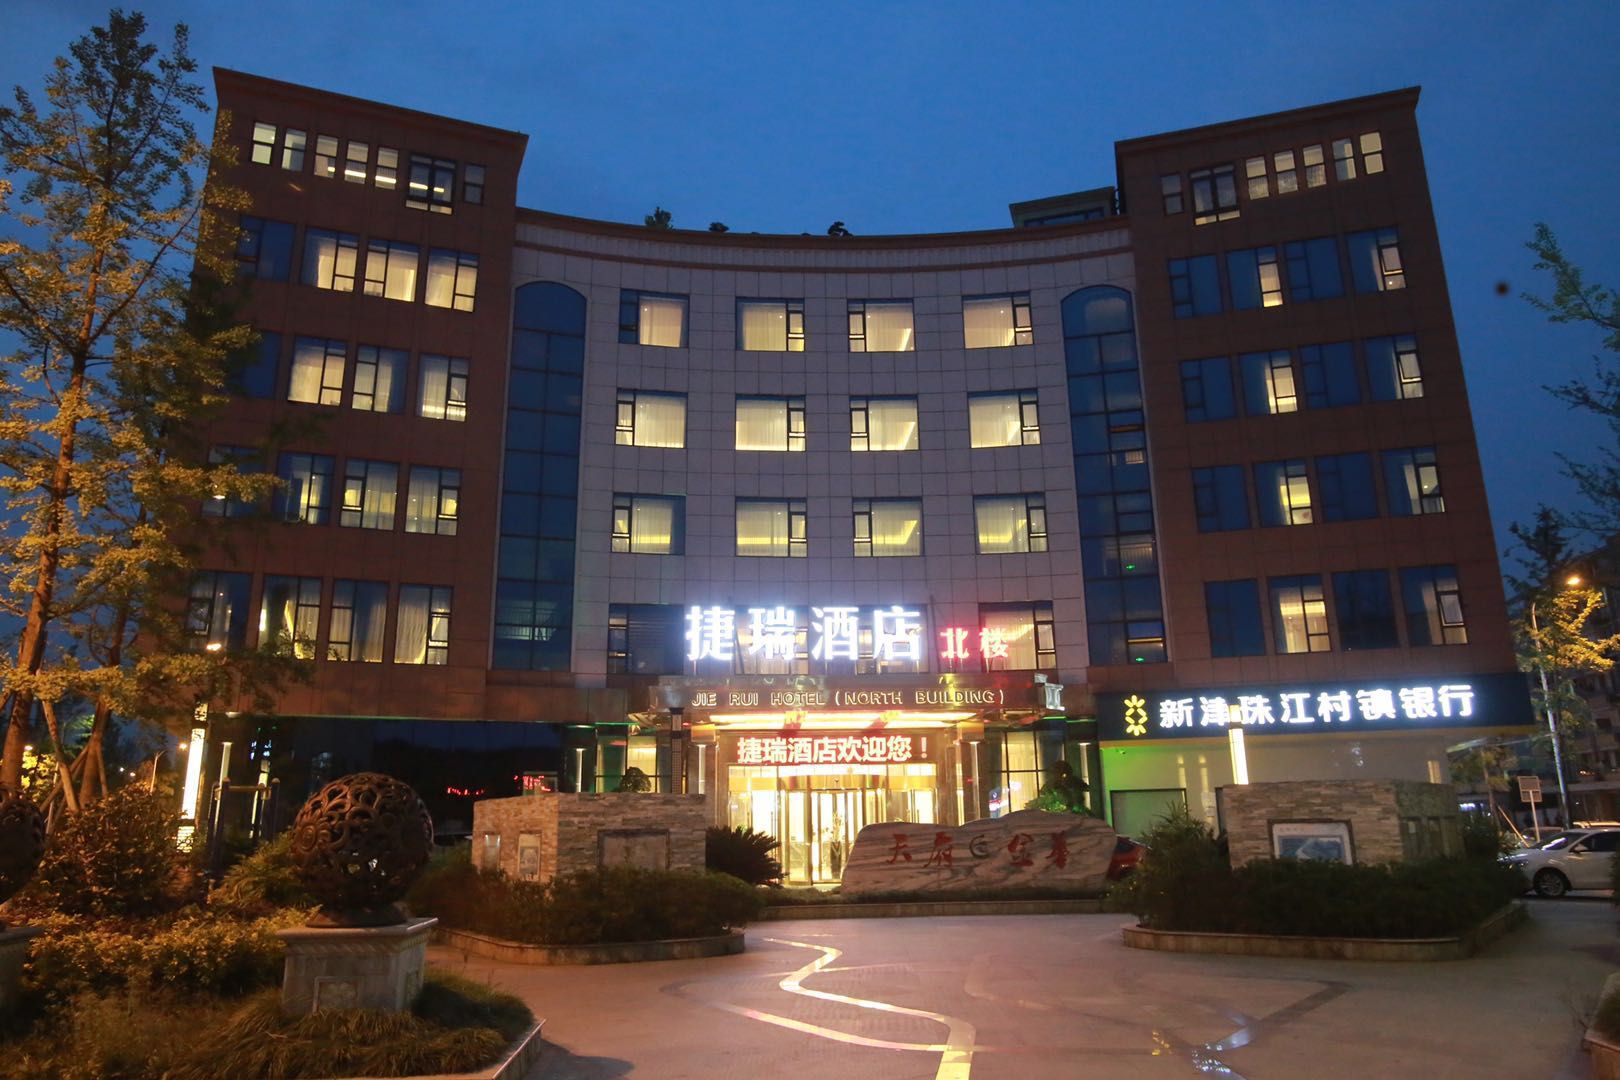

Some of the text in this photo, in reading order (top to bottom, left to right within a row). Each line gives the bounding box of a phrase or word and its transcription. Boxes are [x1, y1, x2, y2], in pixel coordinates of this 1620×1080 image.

[685, 604, 922, 662] 捷瑞酒店
[939, 627, 1011, 659] 北楼
[691, 692, 717, 707] JIE
[730, 692, 759, 706] RUI
[770, 692, 826, 706] HOTEL
[1159, 684, 1475, 729] 新津珠江村镇银行
